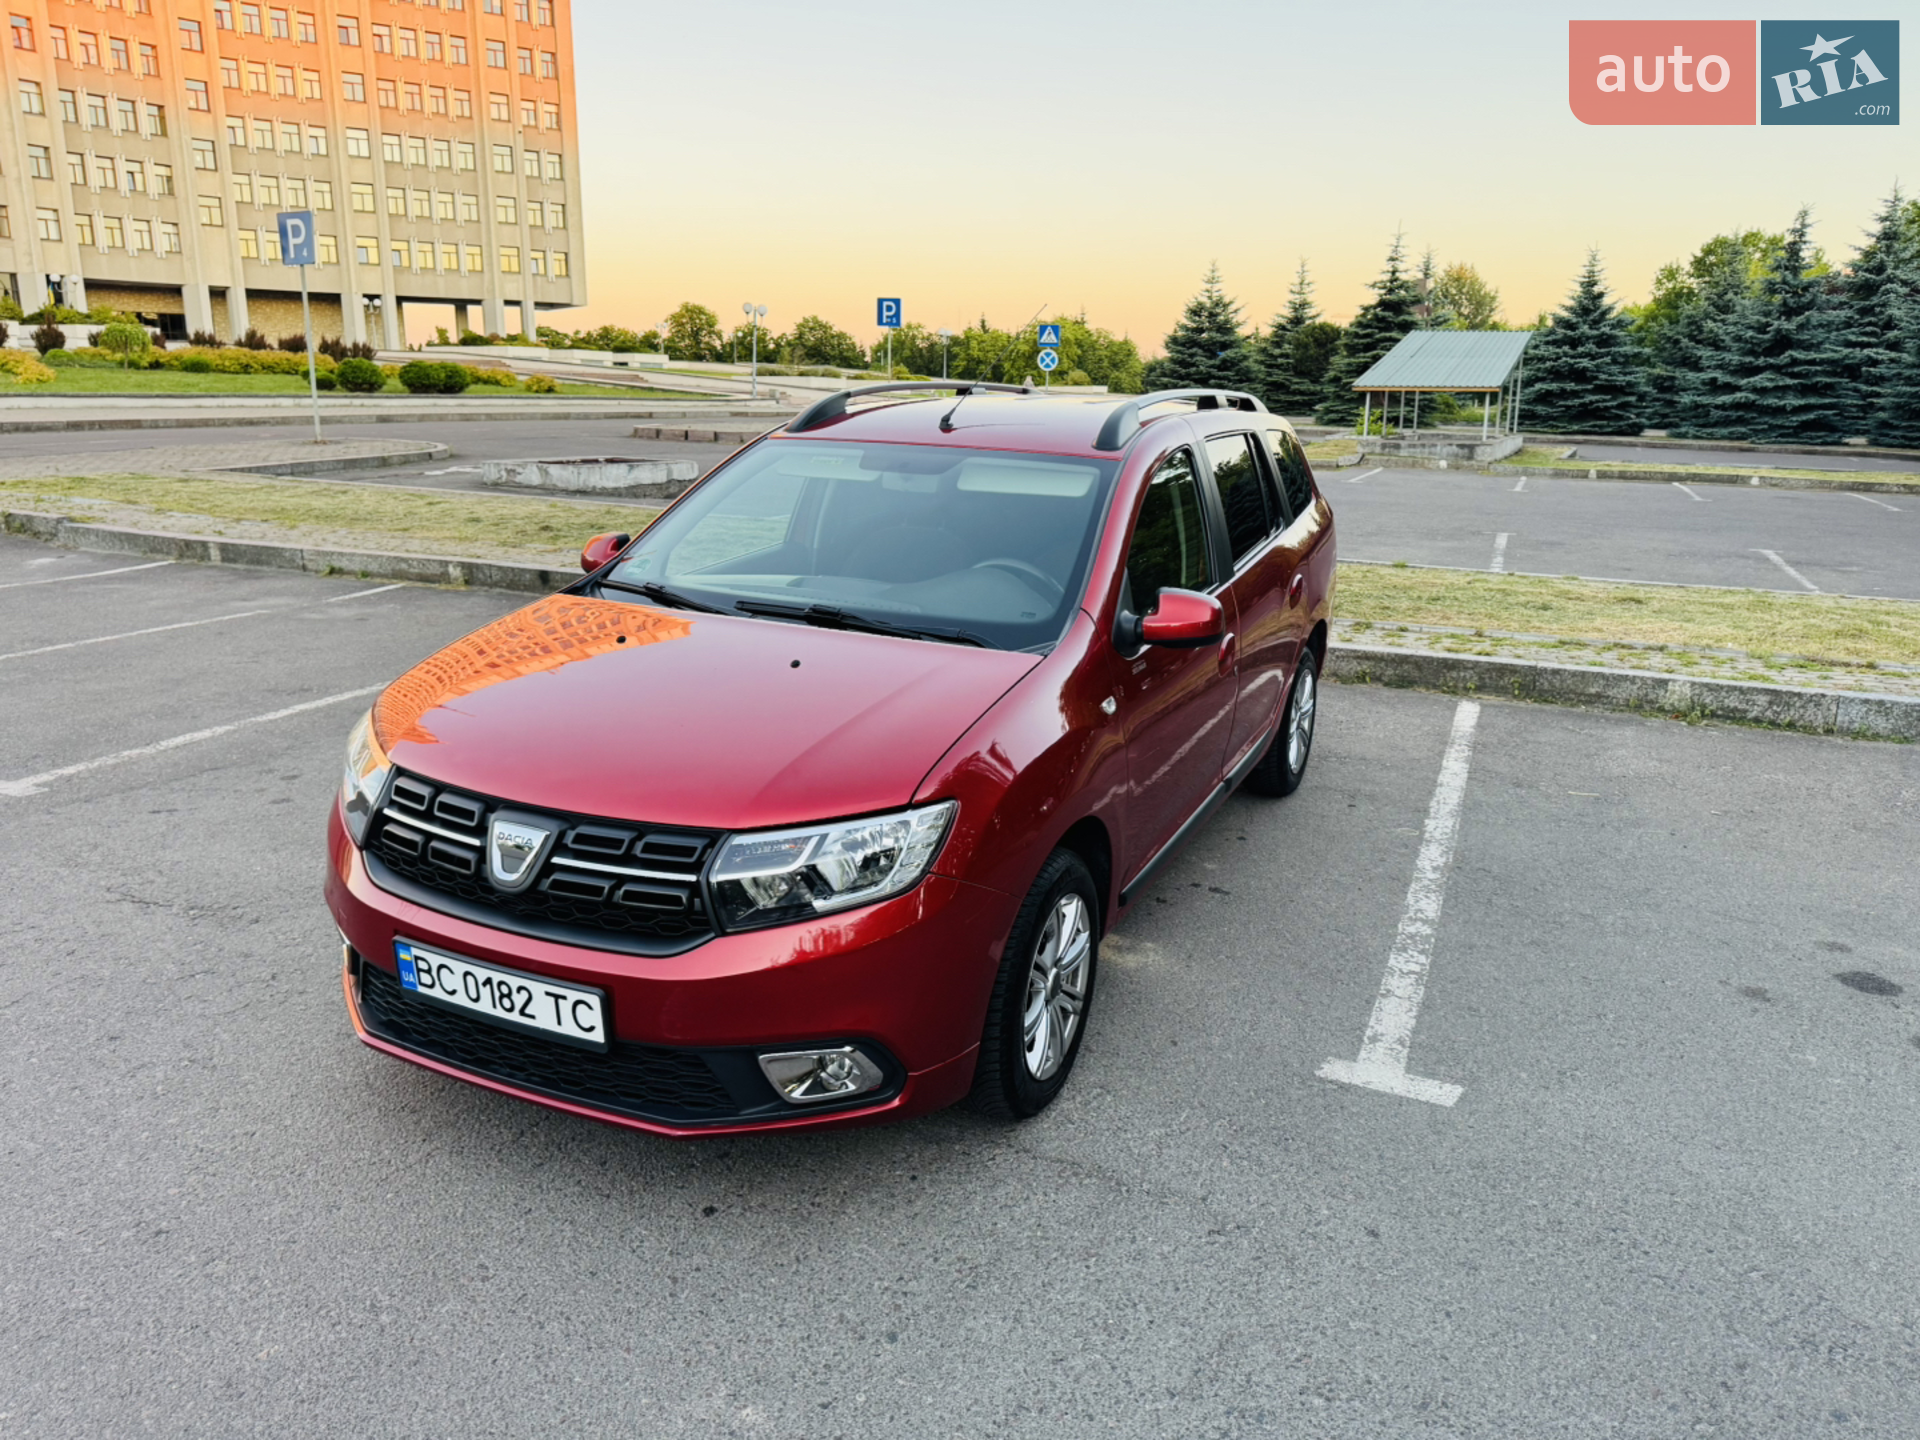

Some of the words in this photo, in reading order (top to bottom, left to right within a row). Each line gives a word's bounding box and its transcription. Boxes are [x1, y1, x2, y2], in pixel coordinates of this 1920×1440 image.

[285, 218, 306, 259] P
[882, 300, 897, 324] P
[497, 831, 534, 846] DACIA
[402, 970, 416, 984] UA
[413, 954, 458, 996] BC
[462, 970, 537, 1020] 0182
[544, 990, 597, 1033] TC
